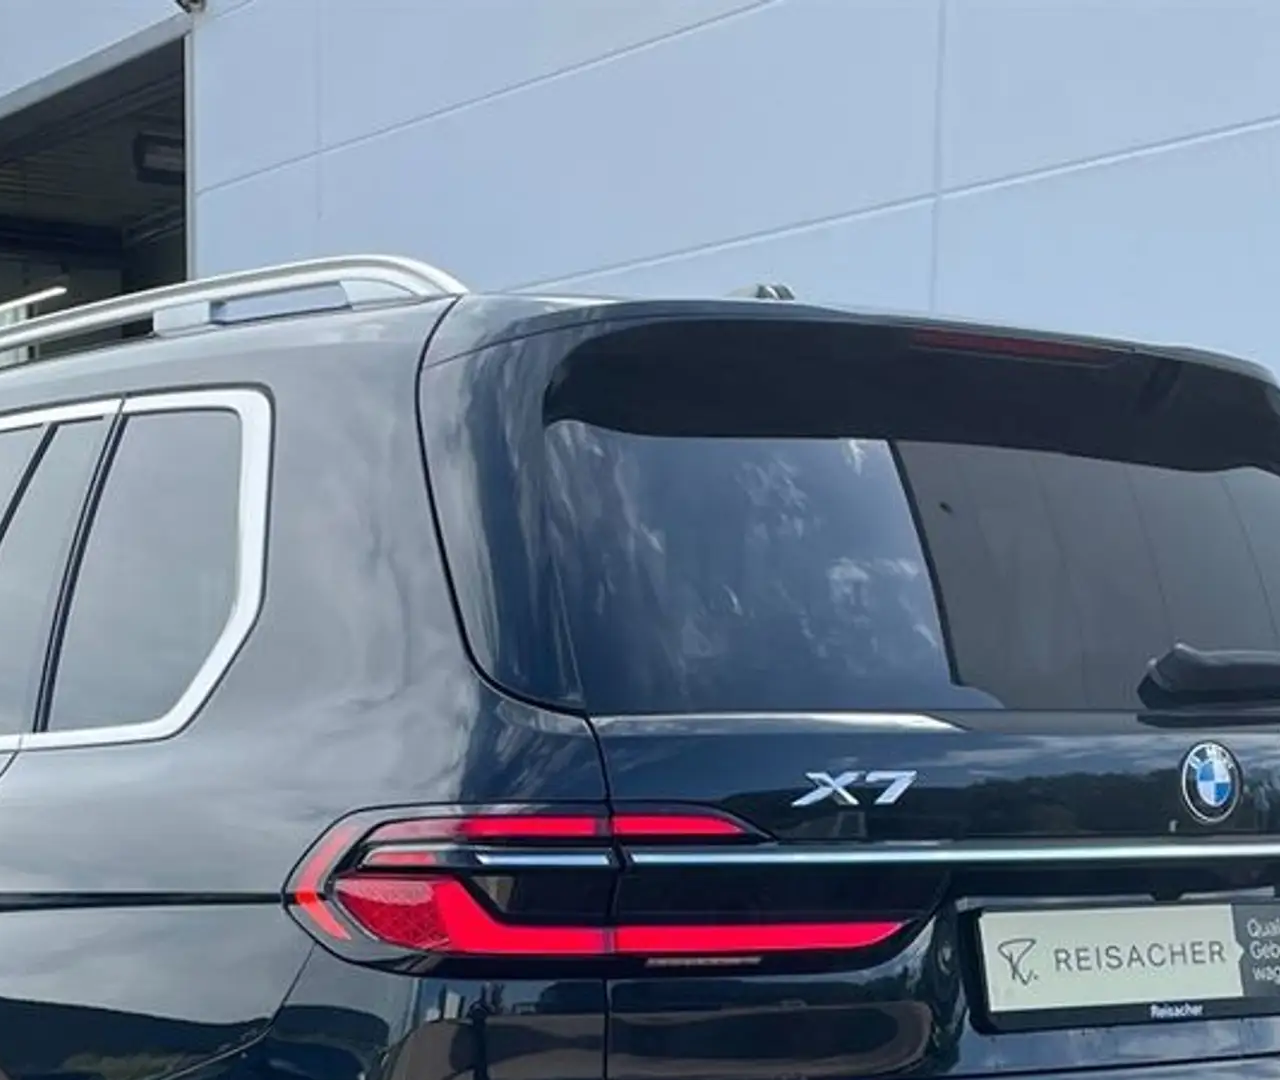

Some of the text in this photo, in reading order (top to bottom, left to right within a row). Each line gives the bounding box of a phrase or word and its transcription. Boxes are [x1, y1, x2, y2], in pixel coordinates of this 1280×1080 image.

[791, 770, 918, 807] X7
[1053, 940, 1227, 972] REISACHER
[1150, 1002, 1203, 1018] Reisacher
